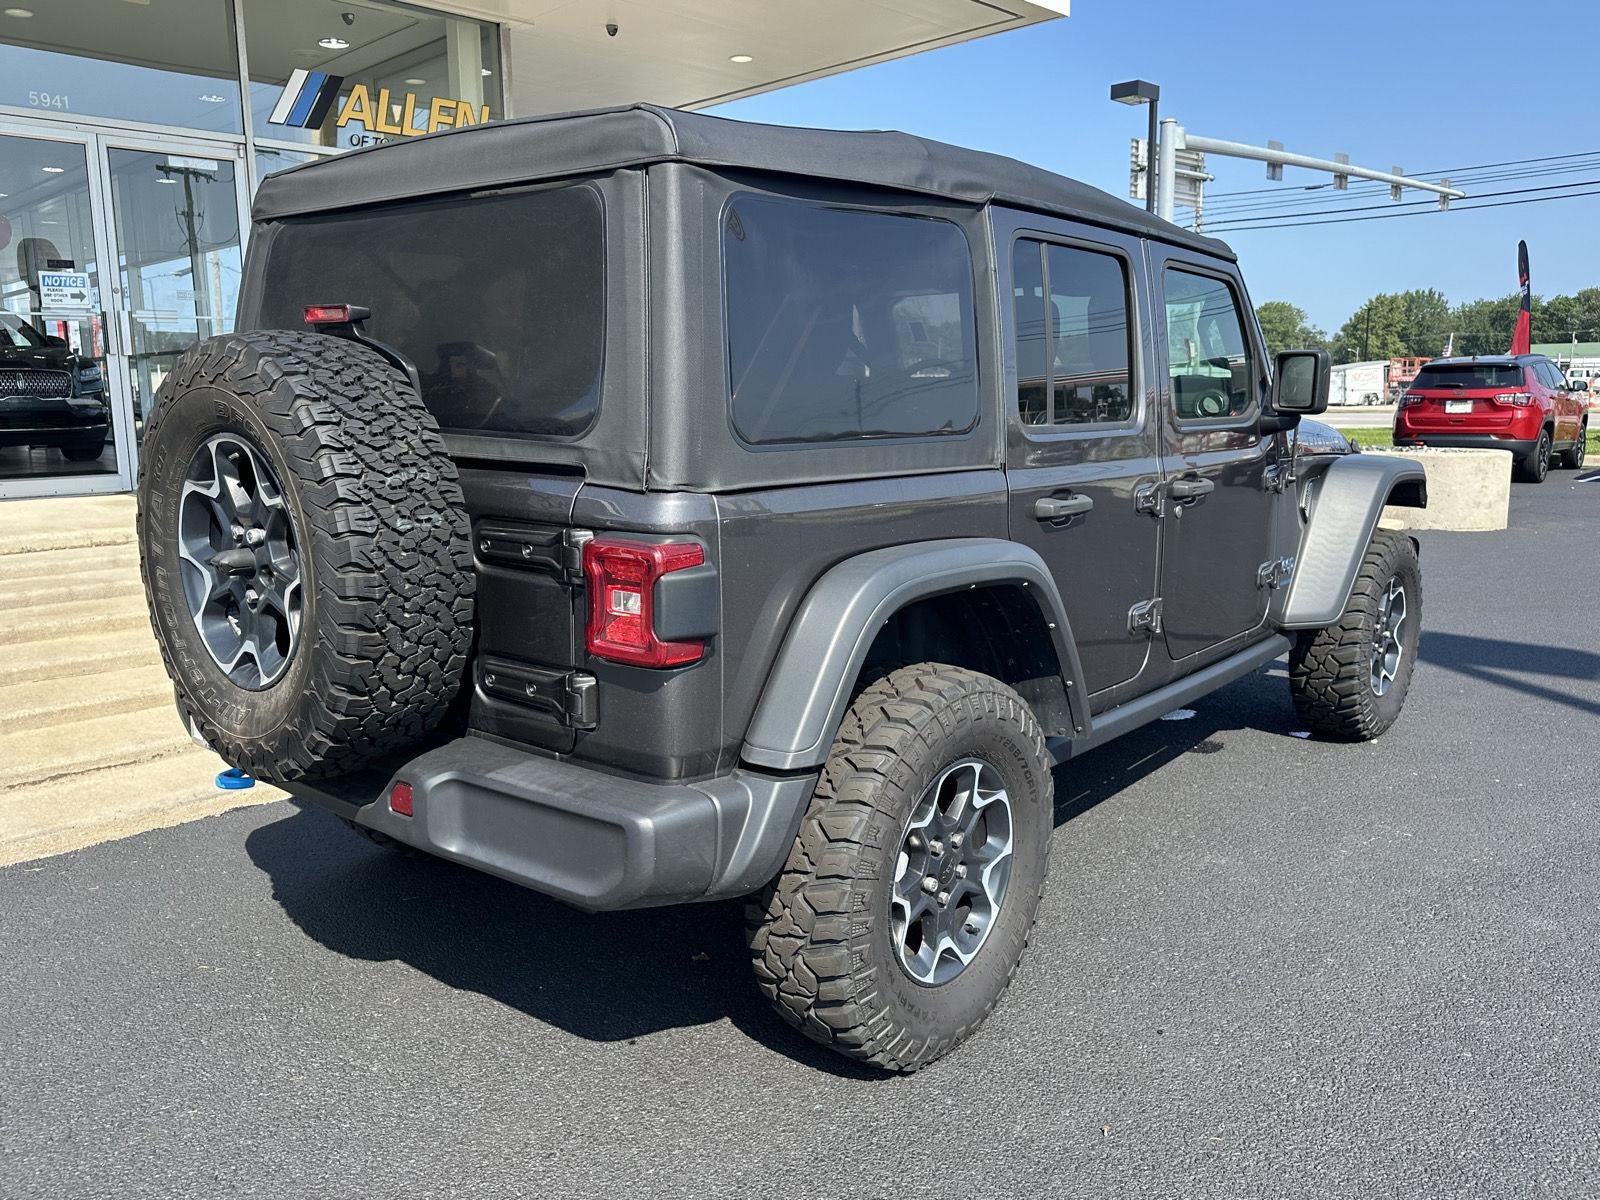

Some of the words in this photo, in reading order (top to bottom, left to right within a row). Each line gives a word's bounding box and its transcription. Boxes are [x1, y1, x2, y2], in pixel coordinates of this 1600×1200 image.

[29, 90, 69, 110] 5941
[336, 83, 490, 137] ALLEN
[350, 133, 370, 147] OF
[44, 276, 84, 287] NOTICE
